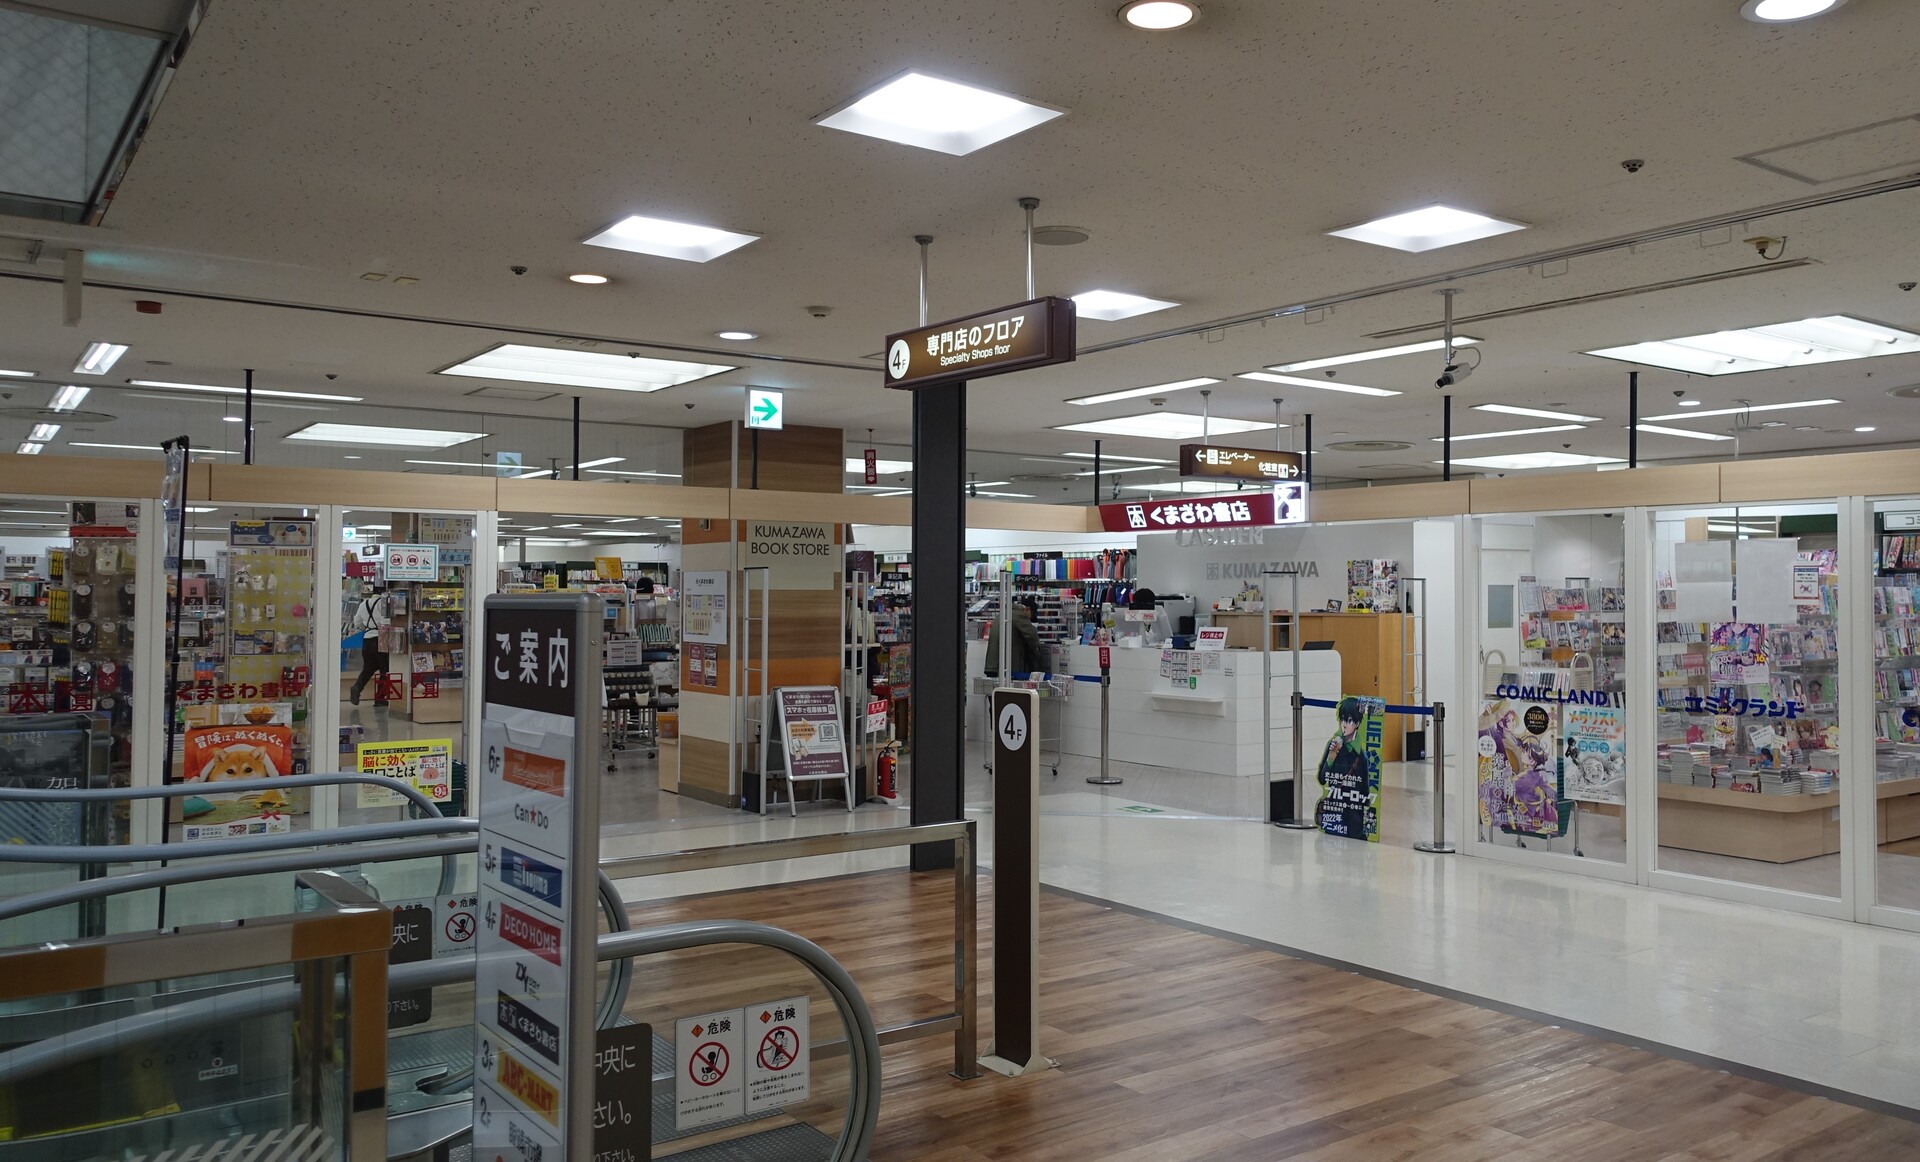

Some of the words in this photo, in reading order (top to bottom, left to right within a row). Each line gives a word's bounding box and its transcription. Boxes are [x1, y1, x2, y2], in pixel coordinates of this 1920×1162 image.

[927, 315, 1025, 357] 専門店のフロア
[940, 352, 969, 367] Specialty
[972, 347, 993, 360] Shops
[994, 343, 1011, 356] floor
[866, 451, 875, 475] 消火器
[1219, 451, 1255, 461] エレベーター
[1258, 462, 1278, 472] 化粧室
[1150, 500, 1252, 525] くまざわ書店
[755, 525, 826, 539] KUMAZAWA
[751, 542, 789, 555] BOOK
[793, 543, 830, 556] STORE
[1223, 561, 1320, 579] KUMAZAWA
[494, 628, 569, 688] ご案内
[176, 682, 302, 701] くまざわ書店
[1496, 684, 1553, 701] COMIC
[1558, 688, 1608, 707] LAND
[1004, 714, 1022, 741] 4F
[1569, 708, 1618, 726] メダリスト
[362, 754, 406, 768] 脳に効く
[488, 745, 500, 774] 6F
[1325, 786, 1378, 804] ブルーロック
[1322, 813, 1342, 823] 2022年
[1322, 822, 1348, 835] アニメ化!!
[485, 843, 497, 874] 5F
[485, 901, 497, 930] 4F
[504, 913, 529, 940] DECO
[529, 926, 557, 954] HOME
[774, 1007, 796, 1022] 危険
[518, 1016, 557, 1052] くまざわ書店
[707, 1020, 731, 1035] 危険
[481, 1039, 493, 1071] 3F
[502, 1056, 553, 1114] ABC-MART
